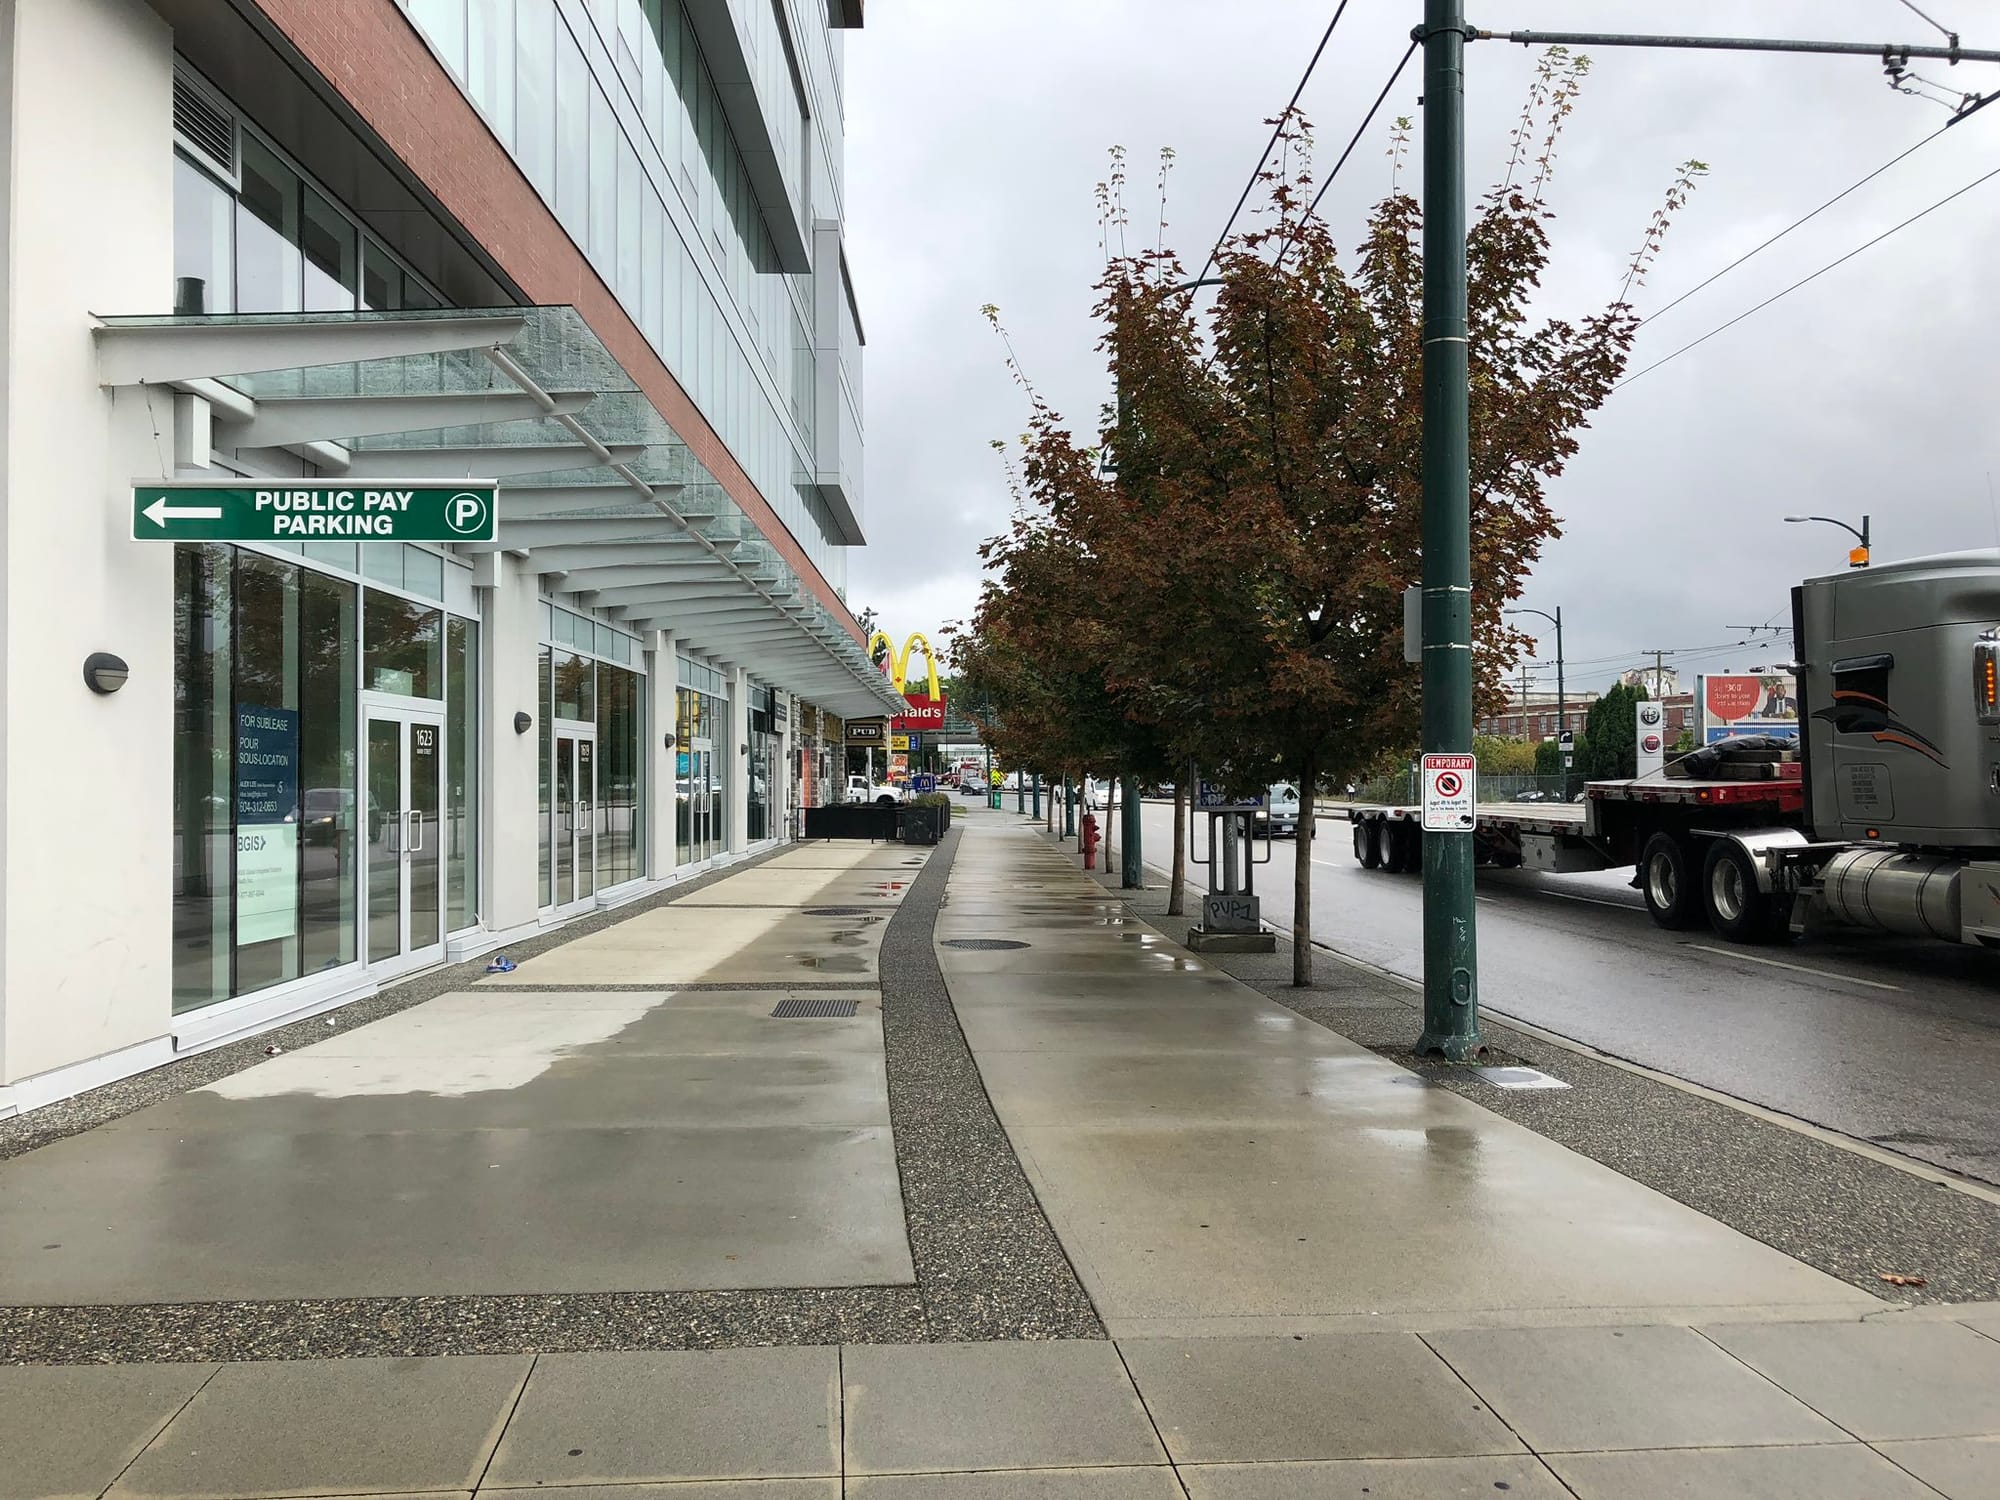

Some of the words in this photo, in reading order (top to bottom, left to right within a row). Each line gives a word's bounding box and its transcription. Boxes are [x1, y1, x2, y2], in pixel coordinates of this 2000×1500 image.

[254, 491, 355, 512] PUBLIC
[363, 491, 414, 511] PAY
[273, 514, 393, 535] PARKING
[240, 714, 256, 728] FOR
[256, 716, 288, 731] SUBLEASE
[240, 736, 259, 750] POUR
[416, 729, 433, 746] 1623
[239, 752, 289, 766] SOUS-LOCATION
[1427, 758, 1471, 769] TEMPORARY
[237, 835, 260, 851] BGIS
